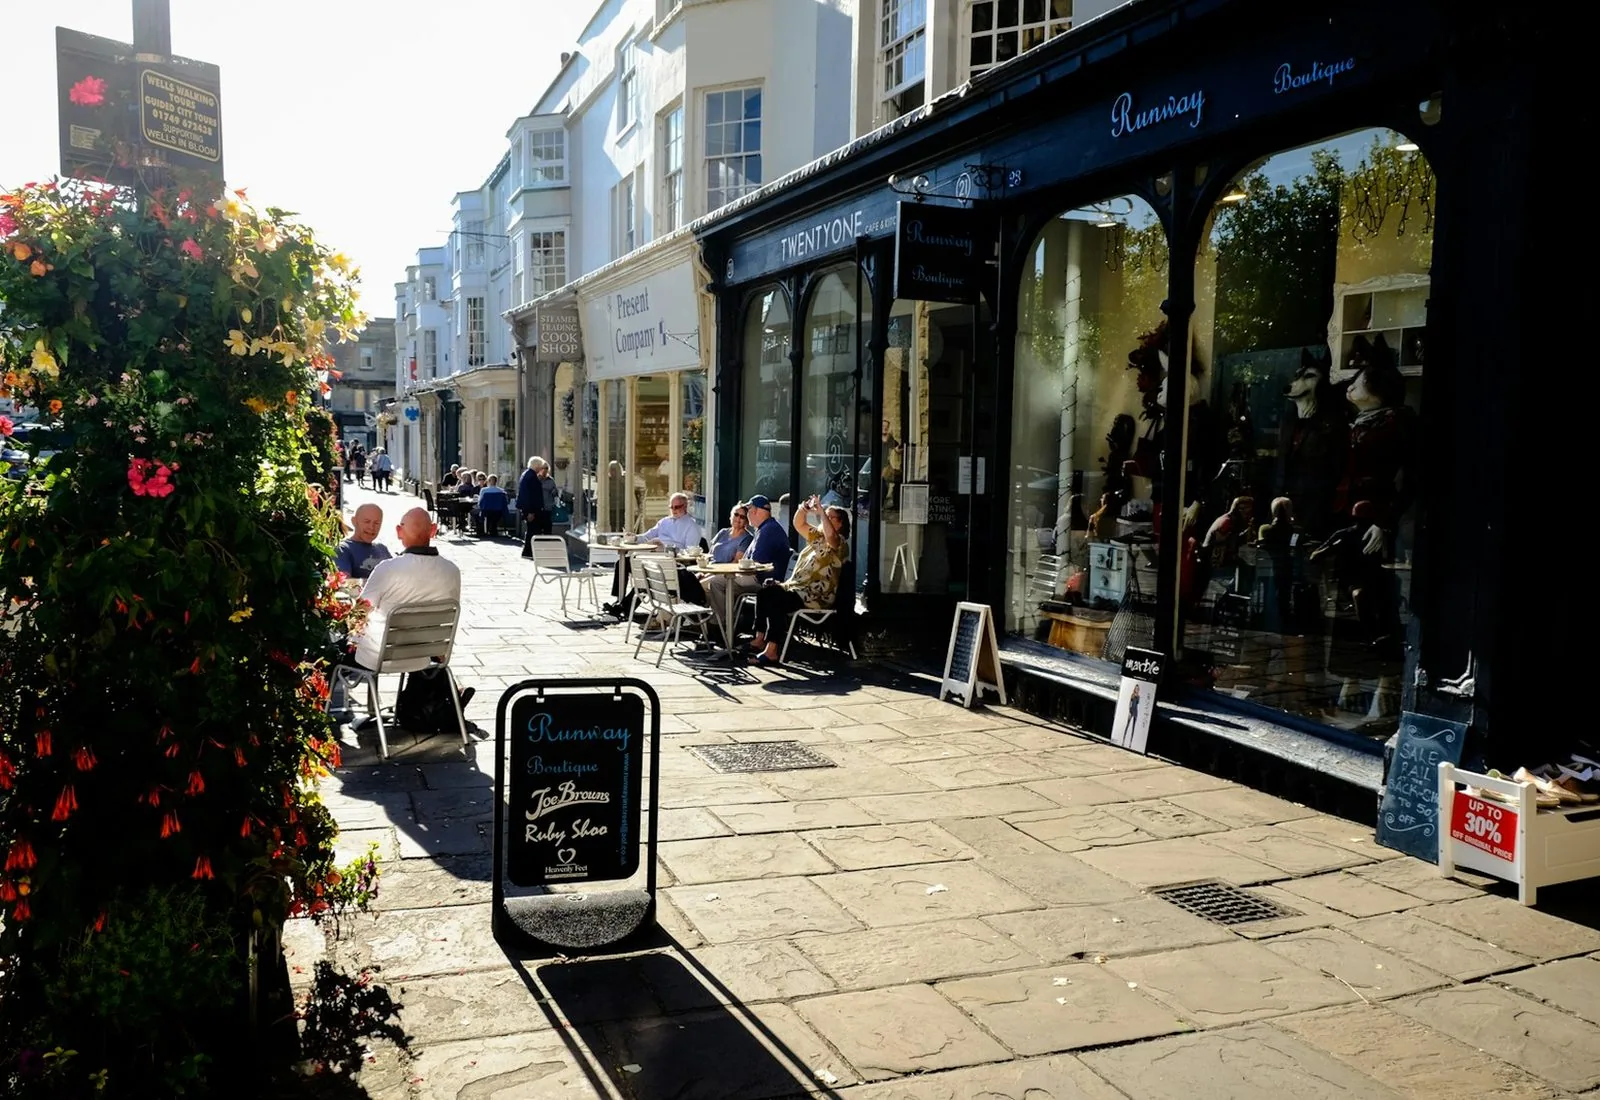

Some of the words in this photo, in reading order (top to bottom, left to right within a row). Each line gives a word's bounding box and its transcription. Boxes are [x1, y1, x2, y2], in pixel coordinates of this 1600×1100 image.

[1273, 55, 1356, 95] Boutique
[146, 75, 174, 92] WELLS
[176, 85, 215, 107] WALKING
[169, 93, 195, 109] TOURS
[144, 96, 175, 112] GUIDED
[177, 106, 192, 118] CITY
[194, 112, 217, 127] TOURS
[1110, 88, 1207, 138] Runway
[146, 128, 176, 144] WELLS
[178, 138, 187, 148] IN
[188, 141, 216, 157] BLOOM
[163, 124, 203, 144] SUPPORTING
[780, 210, 863, 262] TWENTYONE
[906, 219, 973, 257] Runway
[912, 264, 966, 289] Boutique
[617, 286, 650, 319] Present
[540, 315, 577, 323] STEAMER
[542, 324, 578, 332] TRADING
[540, 332, 578, 343] COOK
[541, 343, 578, 354] SHOP
[616, 326, 655, 359] Company
[830, 444, 841, 464] 21
[928, 513, 956, 521] STAIRS
[929, 504, 956, 513] ATING
[528, 712, 631, 751] Runway
[1400, 742, 1439, 766] SALE
[526, 756, 600, 777] Boutique
[1402, 762, 1432, 782] RAIL
[1398, 814, 1416, 824] OFF
[1468, 799, 1484, 812] UP
[1486, 806, 1502, 820] TO
[525, 822, 566, 846] Ruby
[572, 818, 608, 840] Shoo
[1464, 812, 1502, 844] 30%
[1452, 830, 1464, 840] OFF
[1493, 846, 1512, 860] PRICE
[544, 865, 574, 874] Heavenly
[574, 864, 588, 872] Feet
